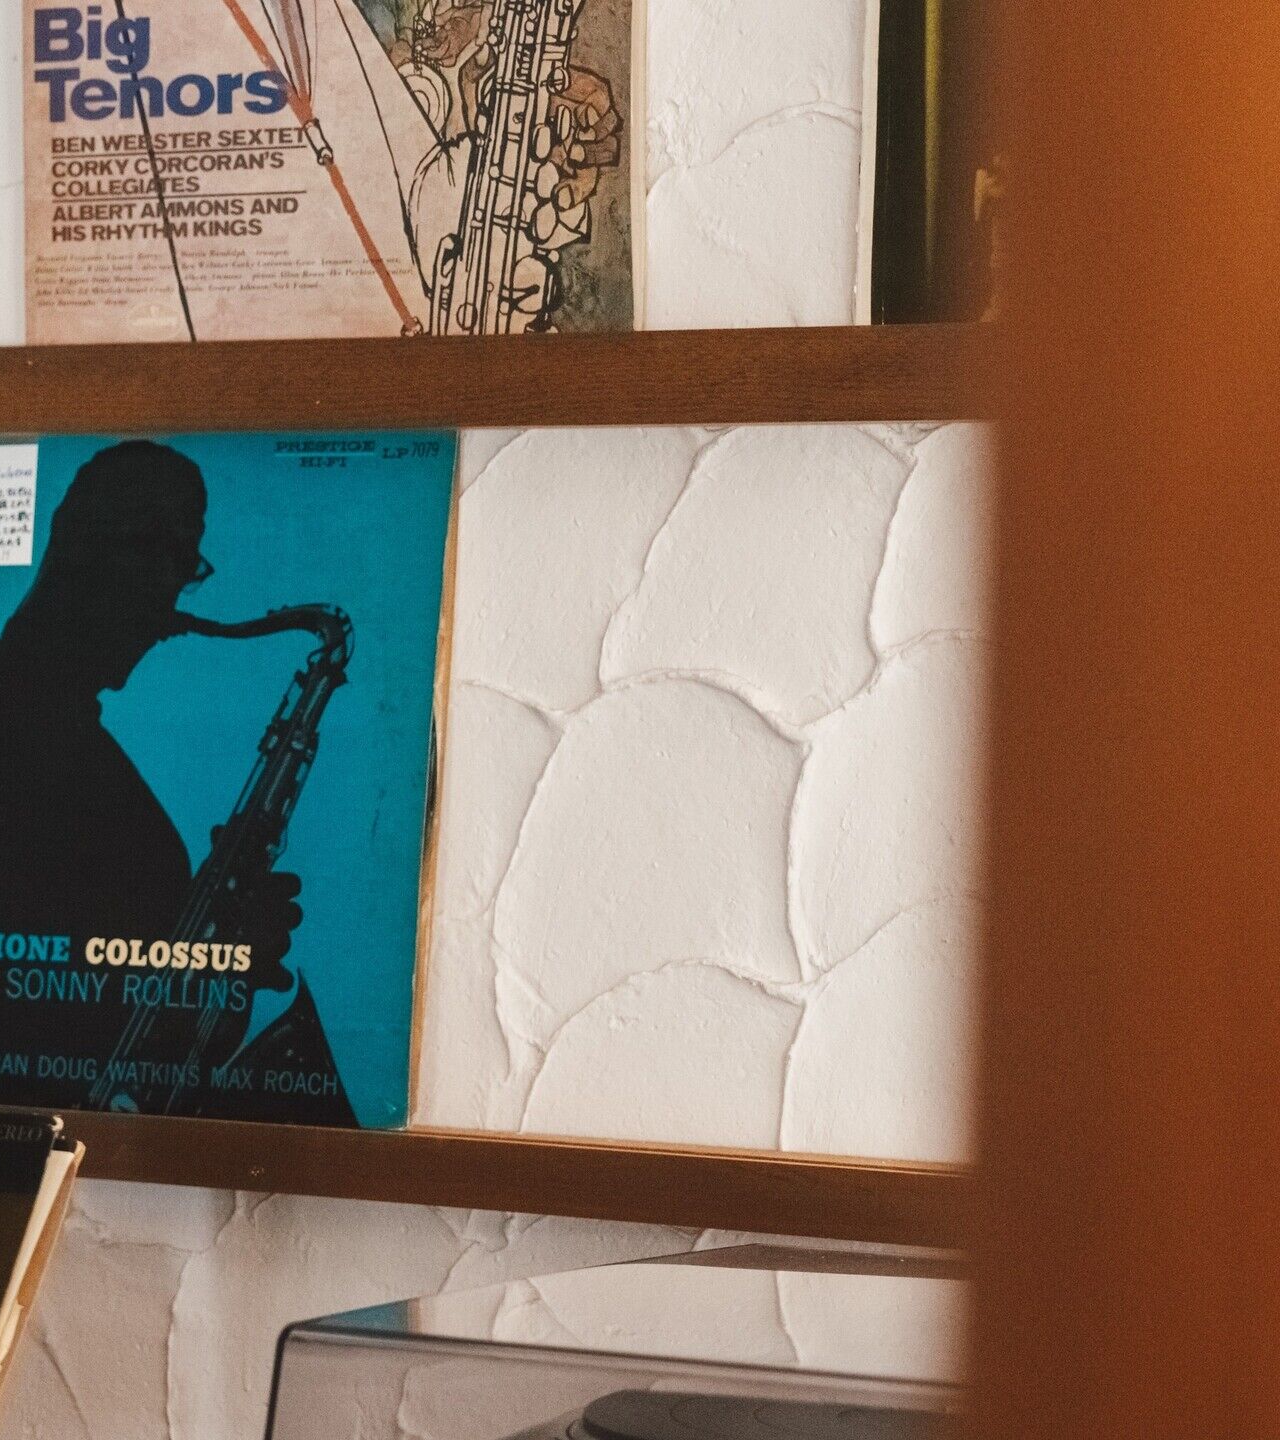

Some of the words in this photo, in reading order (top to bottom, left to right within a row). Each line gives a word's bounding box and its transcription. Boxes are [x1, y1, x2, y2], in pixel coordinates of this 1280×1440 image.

[34, 6, 151, 74] Big
[34, 67, 289, 123] Tenors
[51, 136, 96, 154] BEN
[102, 132, 210, 153] WEBSTER
[217, 127, 307, 147] SEXTET
[52, 157, 130, 179] CORKY
[134, 151, 285, 176] CORCORAN'S
[51, 176, 200, 198] COLLEGIATES
[52, 203, 136, 223] ALBERT
[141, 199, 245, 220] AMMONS
[251, 197, 299, 216] AND
[51, 223, 86, 243] HIS
[91, 221, 188, 241] RHYTHM
[193, 218, 263, 238] KINGS
[85, 937, 252, 972] COLOSSUS
[5, 967, 109, 1002] SONNY
[123, 974, 248, 1012] ROLLINS
[38, 1056, 98, 1081] DOUG
[105, 1060, 200, 1087] WATKINS
[210, 1065, 254, 1090] MAX
[264, 1070, 338, 1096] ROACH
